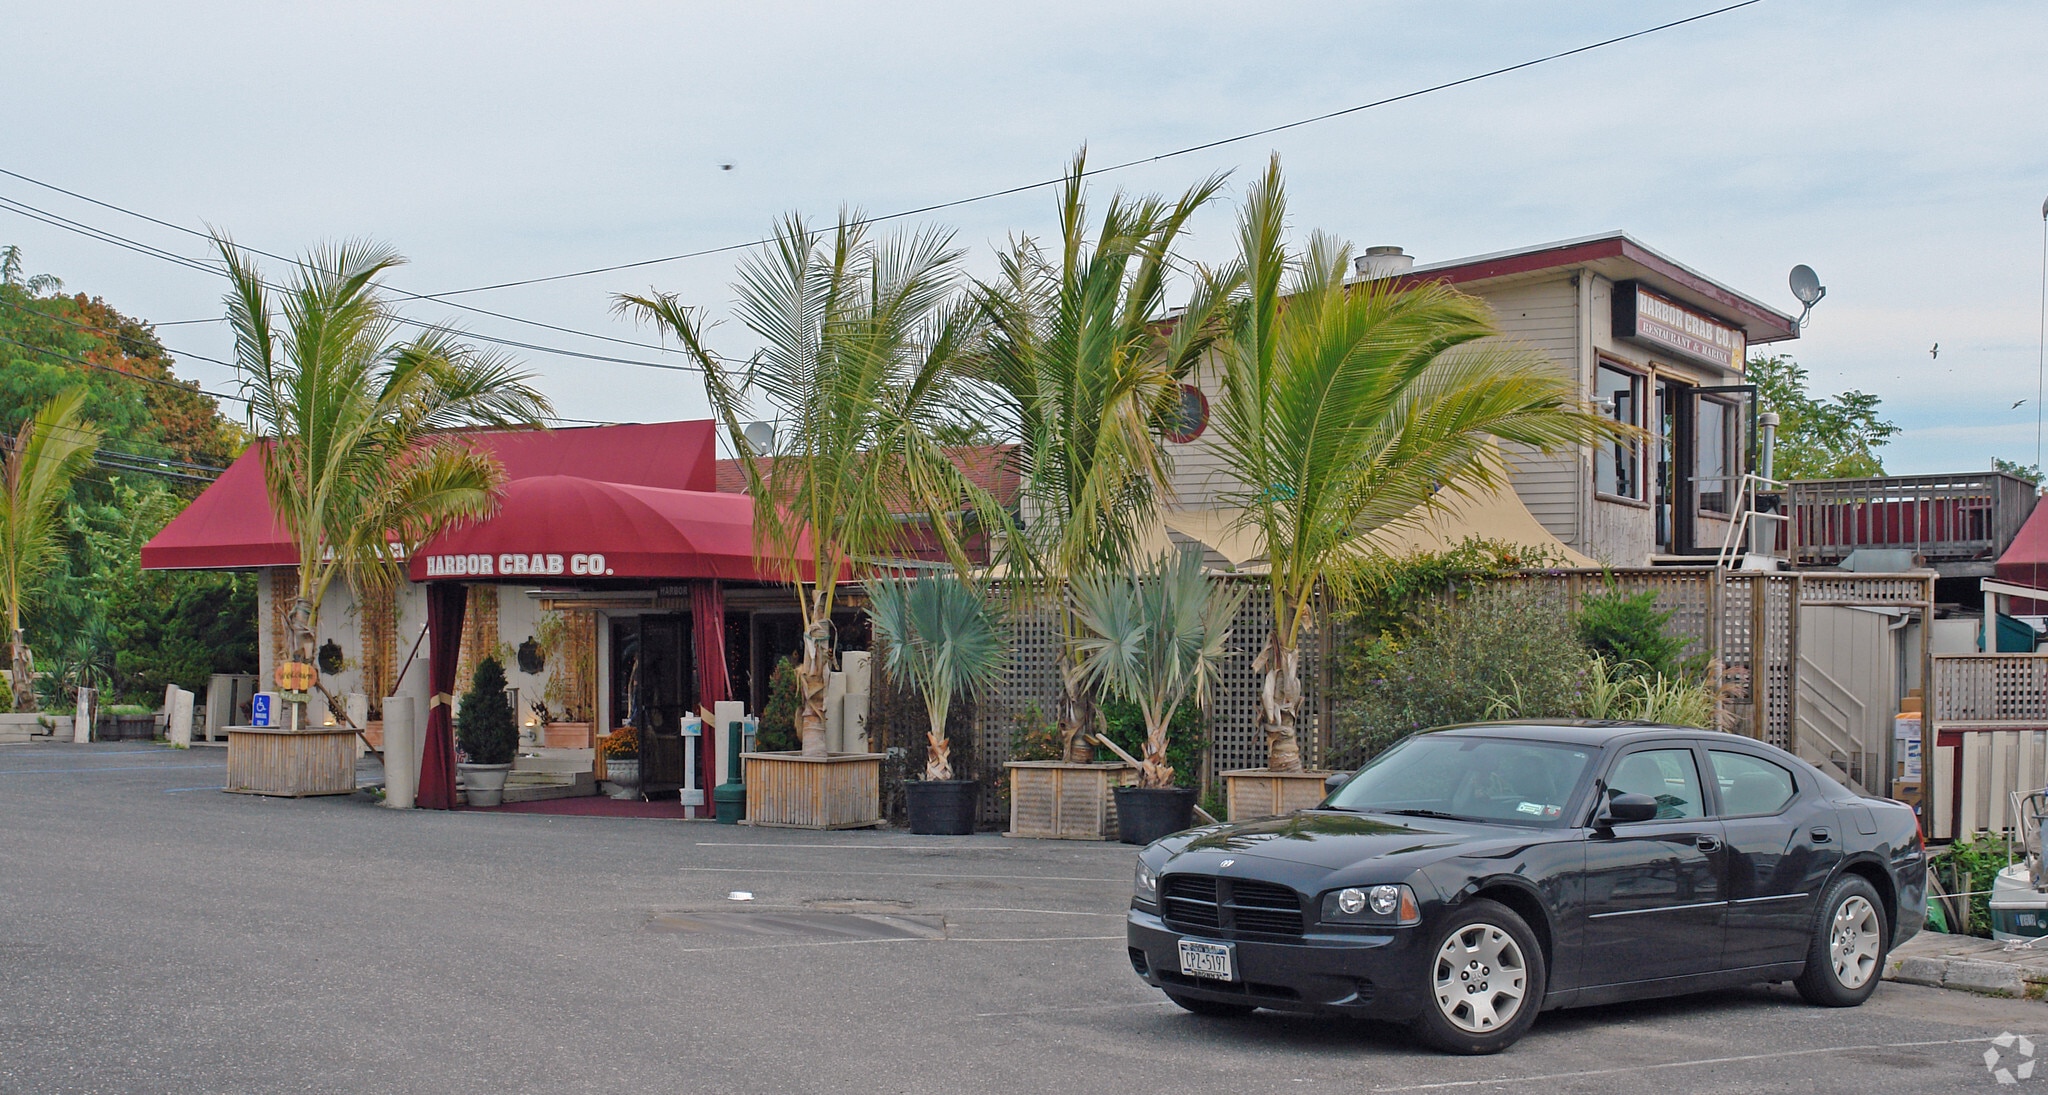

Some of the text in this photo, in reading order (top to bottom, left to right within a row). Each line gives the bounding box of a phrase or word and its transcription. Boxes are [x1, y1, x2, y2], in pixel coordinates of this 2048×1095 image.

[1639, 292, 1731, 349] HARBOR CRAB CO.
[1643, 322, 1727, 363] RESTAURANT & MARINA
[426, 553, 614, 576] HARBOR CRAB CO.
